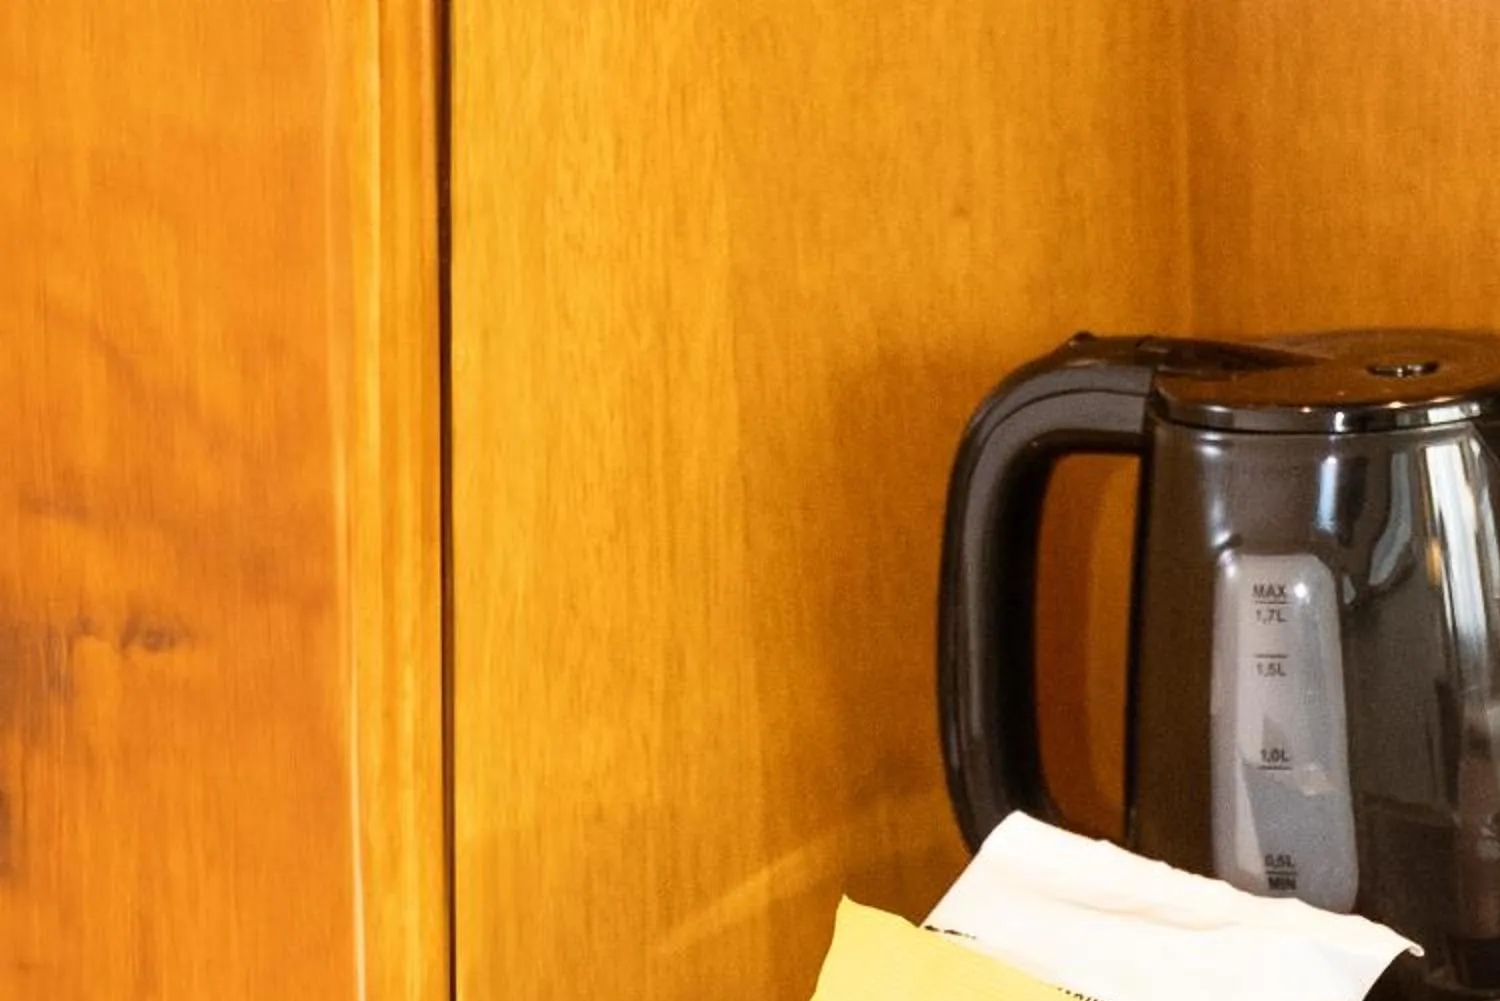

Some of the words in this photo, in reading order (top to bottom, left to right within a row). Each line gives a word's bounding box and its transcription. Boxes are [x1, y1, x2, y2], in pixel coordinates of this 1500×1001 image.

[1253, 583, 1287, 599] MAX
[1256, 609, 1287, 624] 1,7L
[1256, 663, 1287, 678] 1,5L
[1268, 876, 1297, 891] MIN
